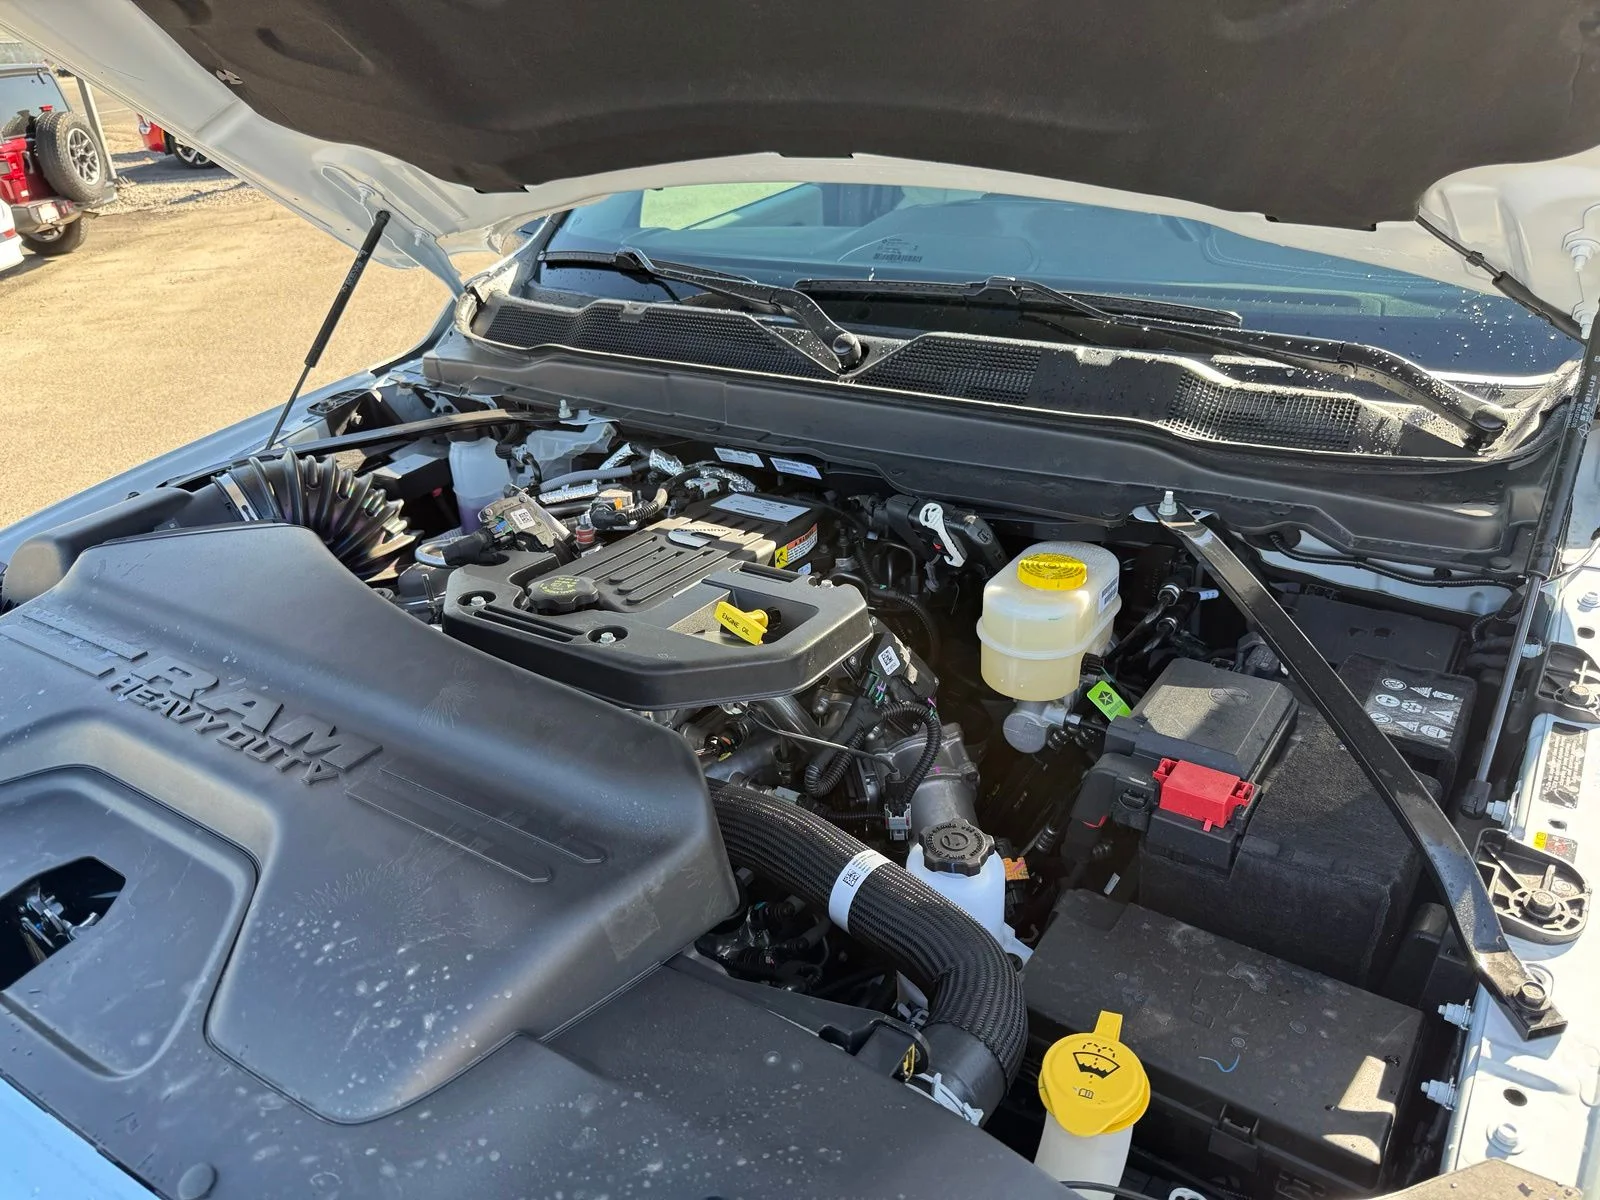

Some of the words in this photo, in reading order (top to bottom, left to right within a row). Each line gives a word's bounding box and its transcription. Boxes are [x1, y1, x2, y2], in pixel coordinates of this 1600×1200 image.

[1580, 375, 1597, 420] STABILUS
[721, 612, 740, 629] ENGINE
[741, 626, 750, 636] OIL
[106, 675, 229, 735] HEAVY
[216, 726, 339, 785] DUTY
[130, 655, 383, 772] RAM
